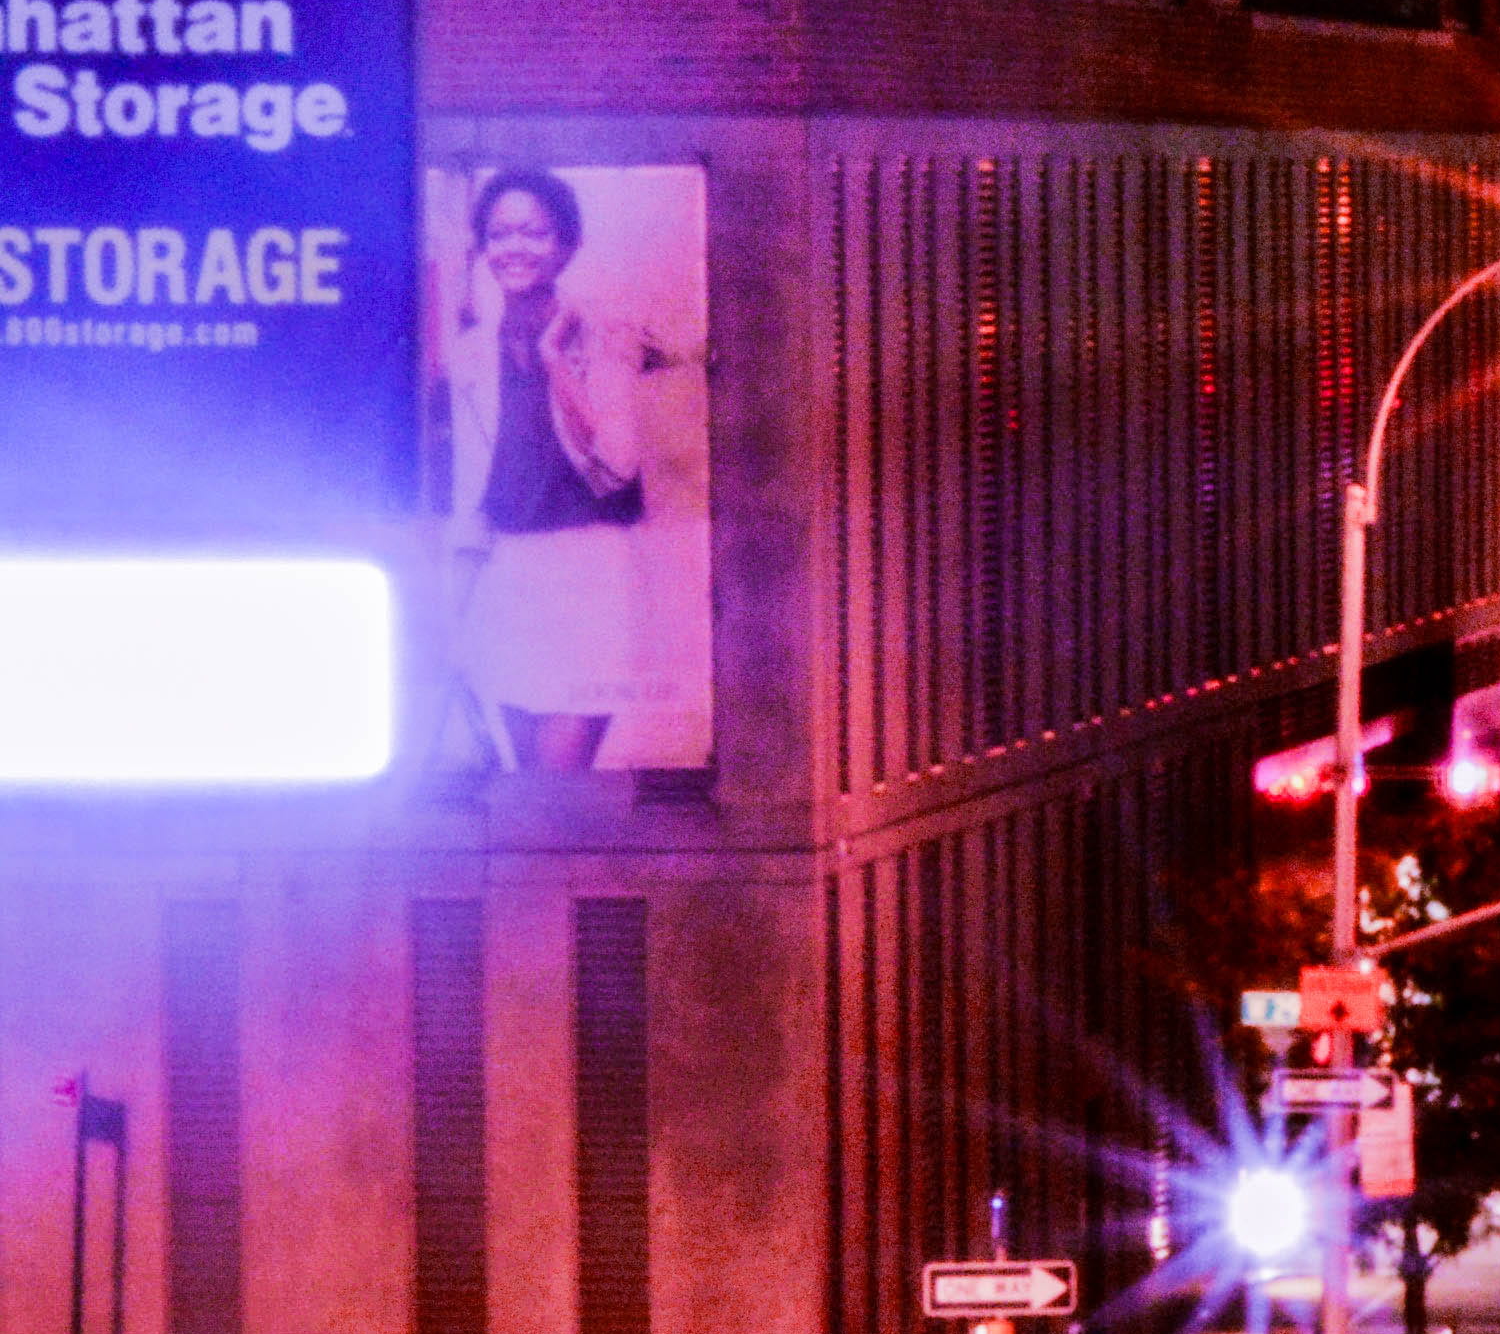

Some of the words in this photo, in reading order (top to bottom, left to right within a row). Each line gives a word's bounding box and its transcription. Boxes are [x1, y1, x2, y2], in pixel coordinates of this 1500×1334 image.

[14, 64, 348, 153] Storage
[0, 226, 347, 306] STORAGE
[0, 317, 258, 352] 800storage.com
